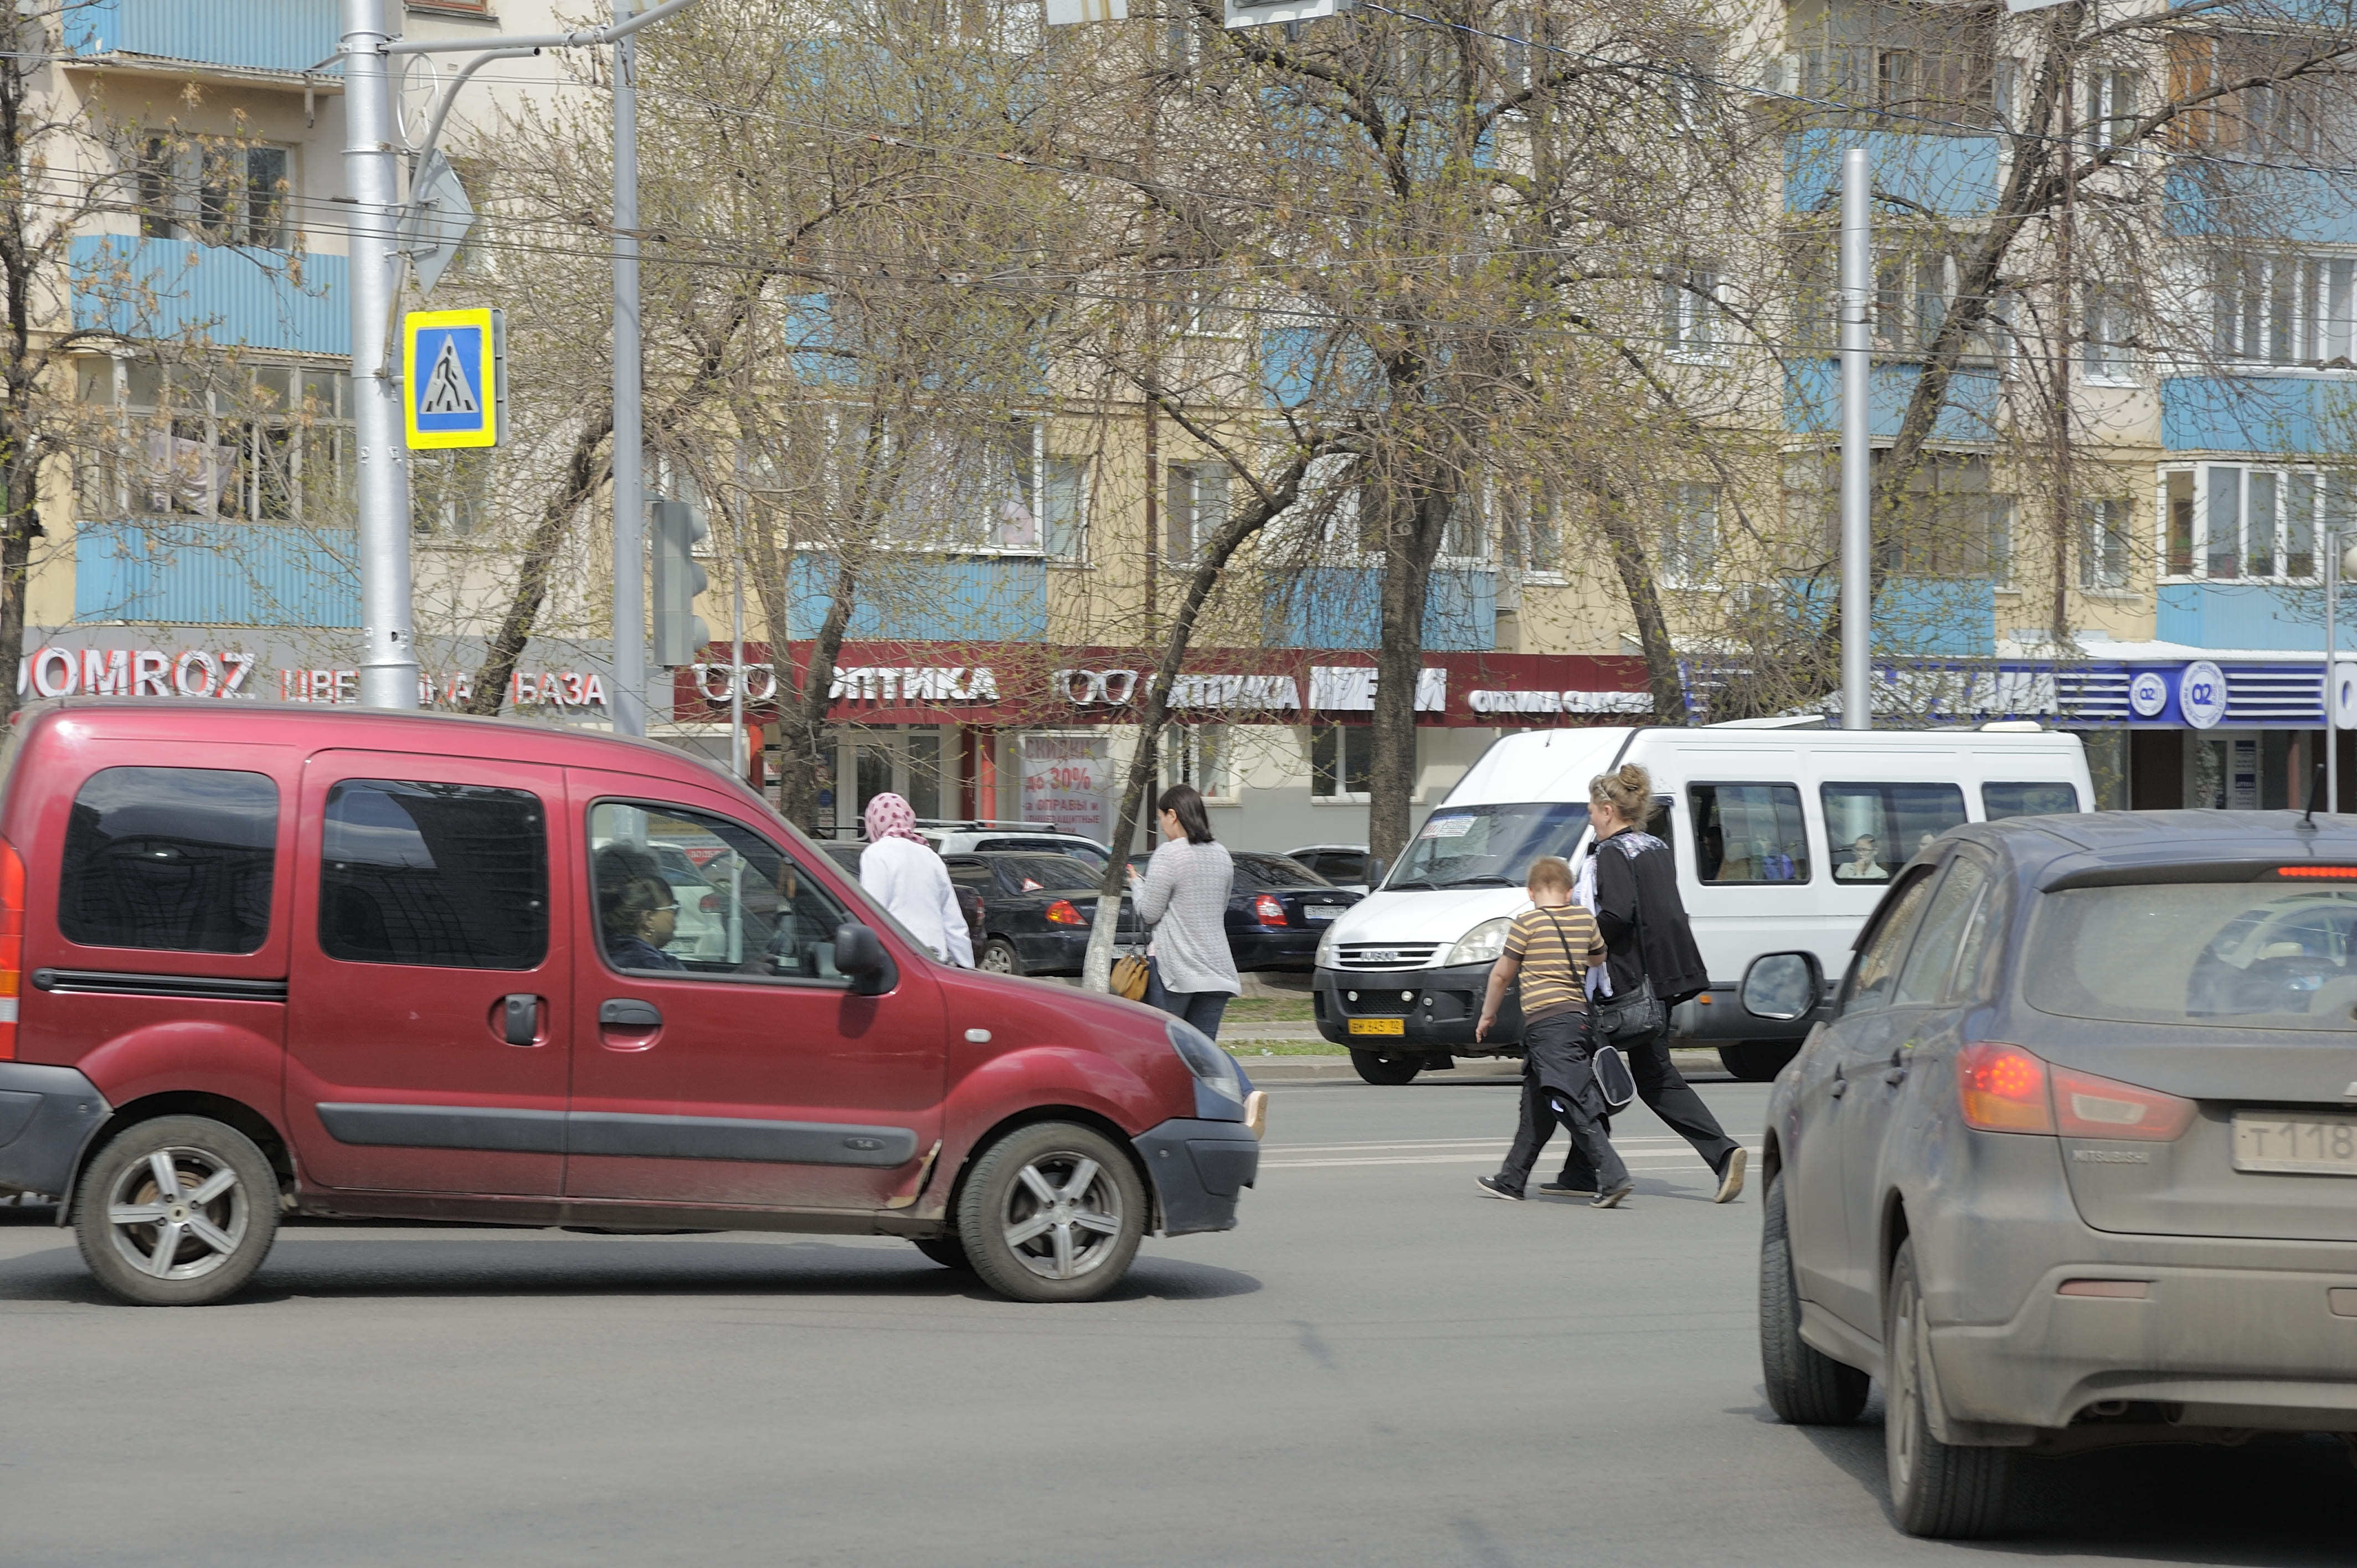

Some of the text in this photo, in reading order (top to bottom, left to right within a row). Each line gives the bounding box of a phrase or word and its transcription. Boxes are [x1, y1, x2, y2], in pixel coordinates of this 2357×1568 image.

[17, 647, 255, 699] OMROZ
[512, 673, 608, 705] БАЗА
[1050, 767, 1092, 791] 30%
[1037, 799, 1087, 811] ОПРАВЫ
[2072, 1149, 2149, 1164] MITSUBISHI
